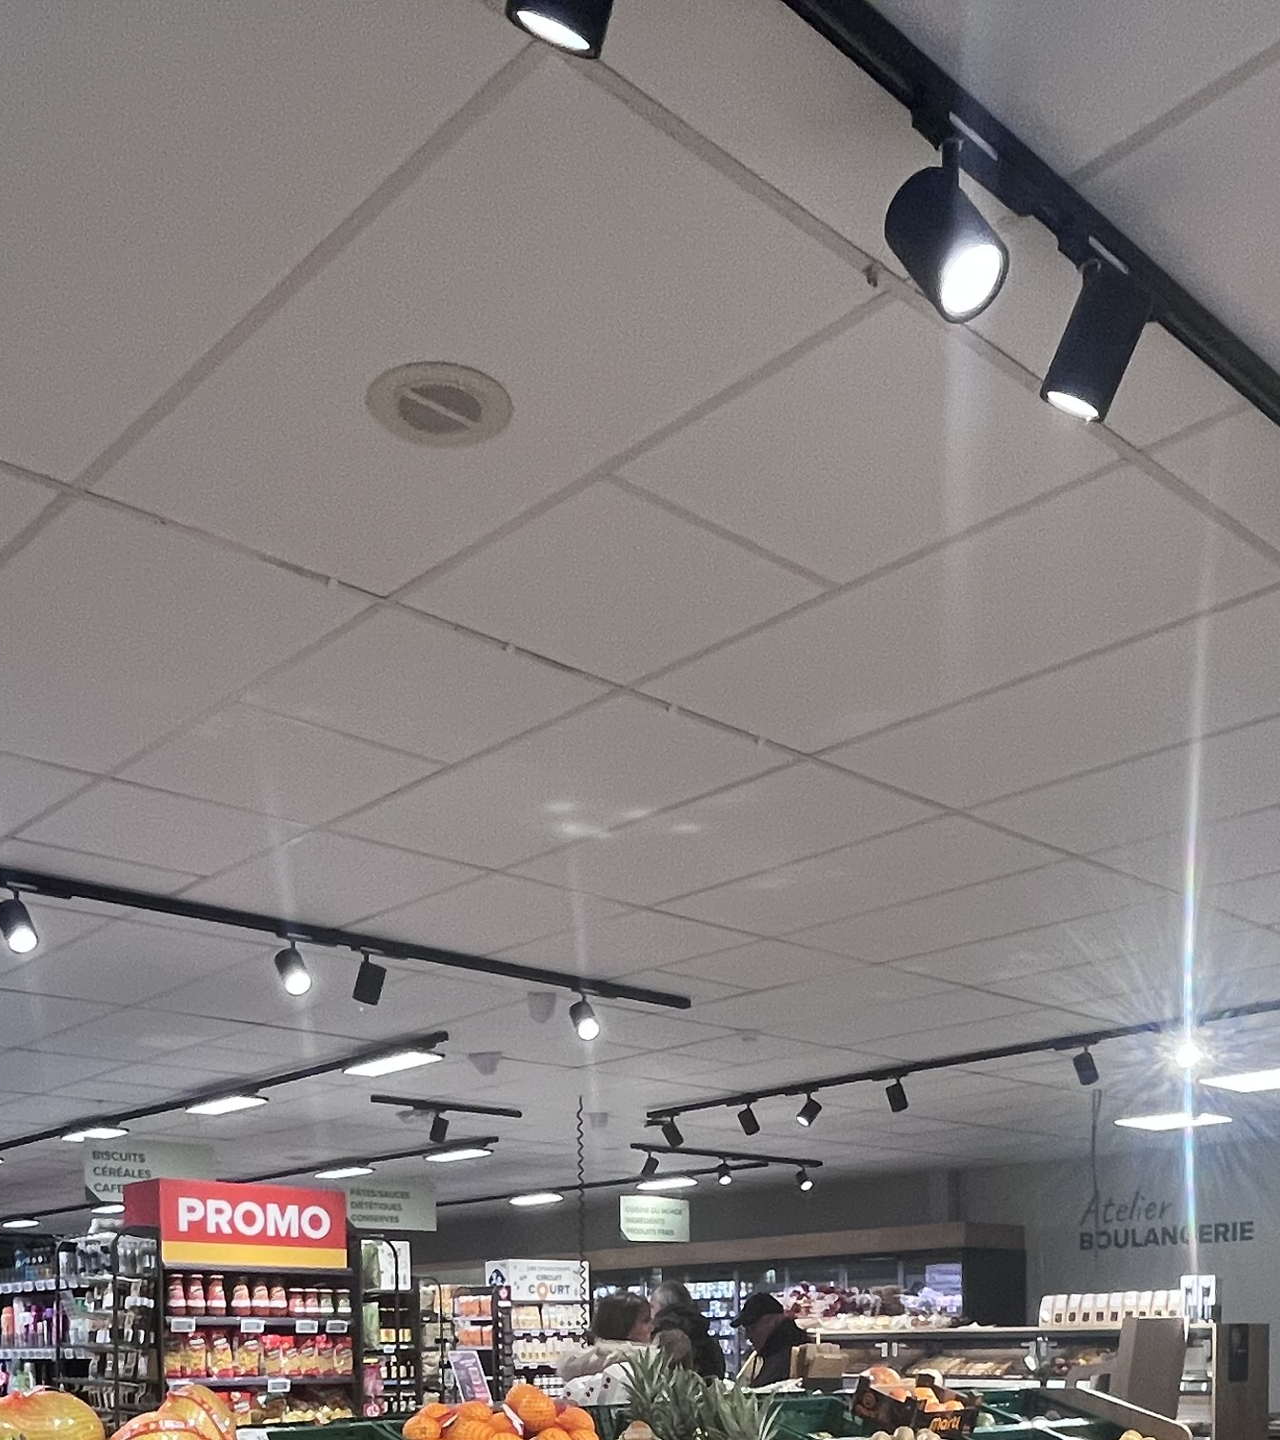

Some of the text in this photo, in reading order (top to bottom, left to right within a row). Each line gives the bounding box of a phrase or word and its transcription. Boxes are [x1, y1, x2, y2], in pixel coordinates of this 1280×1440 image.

[92, 1150, 146, 1164] BISCUITS
[93, 1166, 152, 1179] CÉRÉALES
[178, 1196, 331, 1240] PROMO
[1079, 1190, 1173, 1227] Atelier
